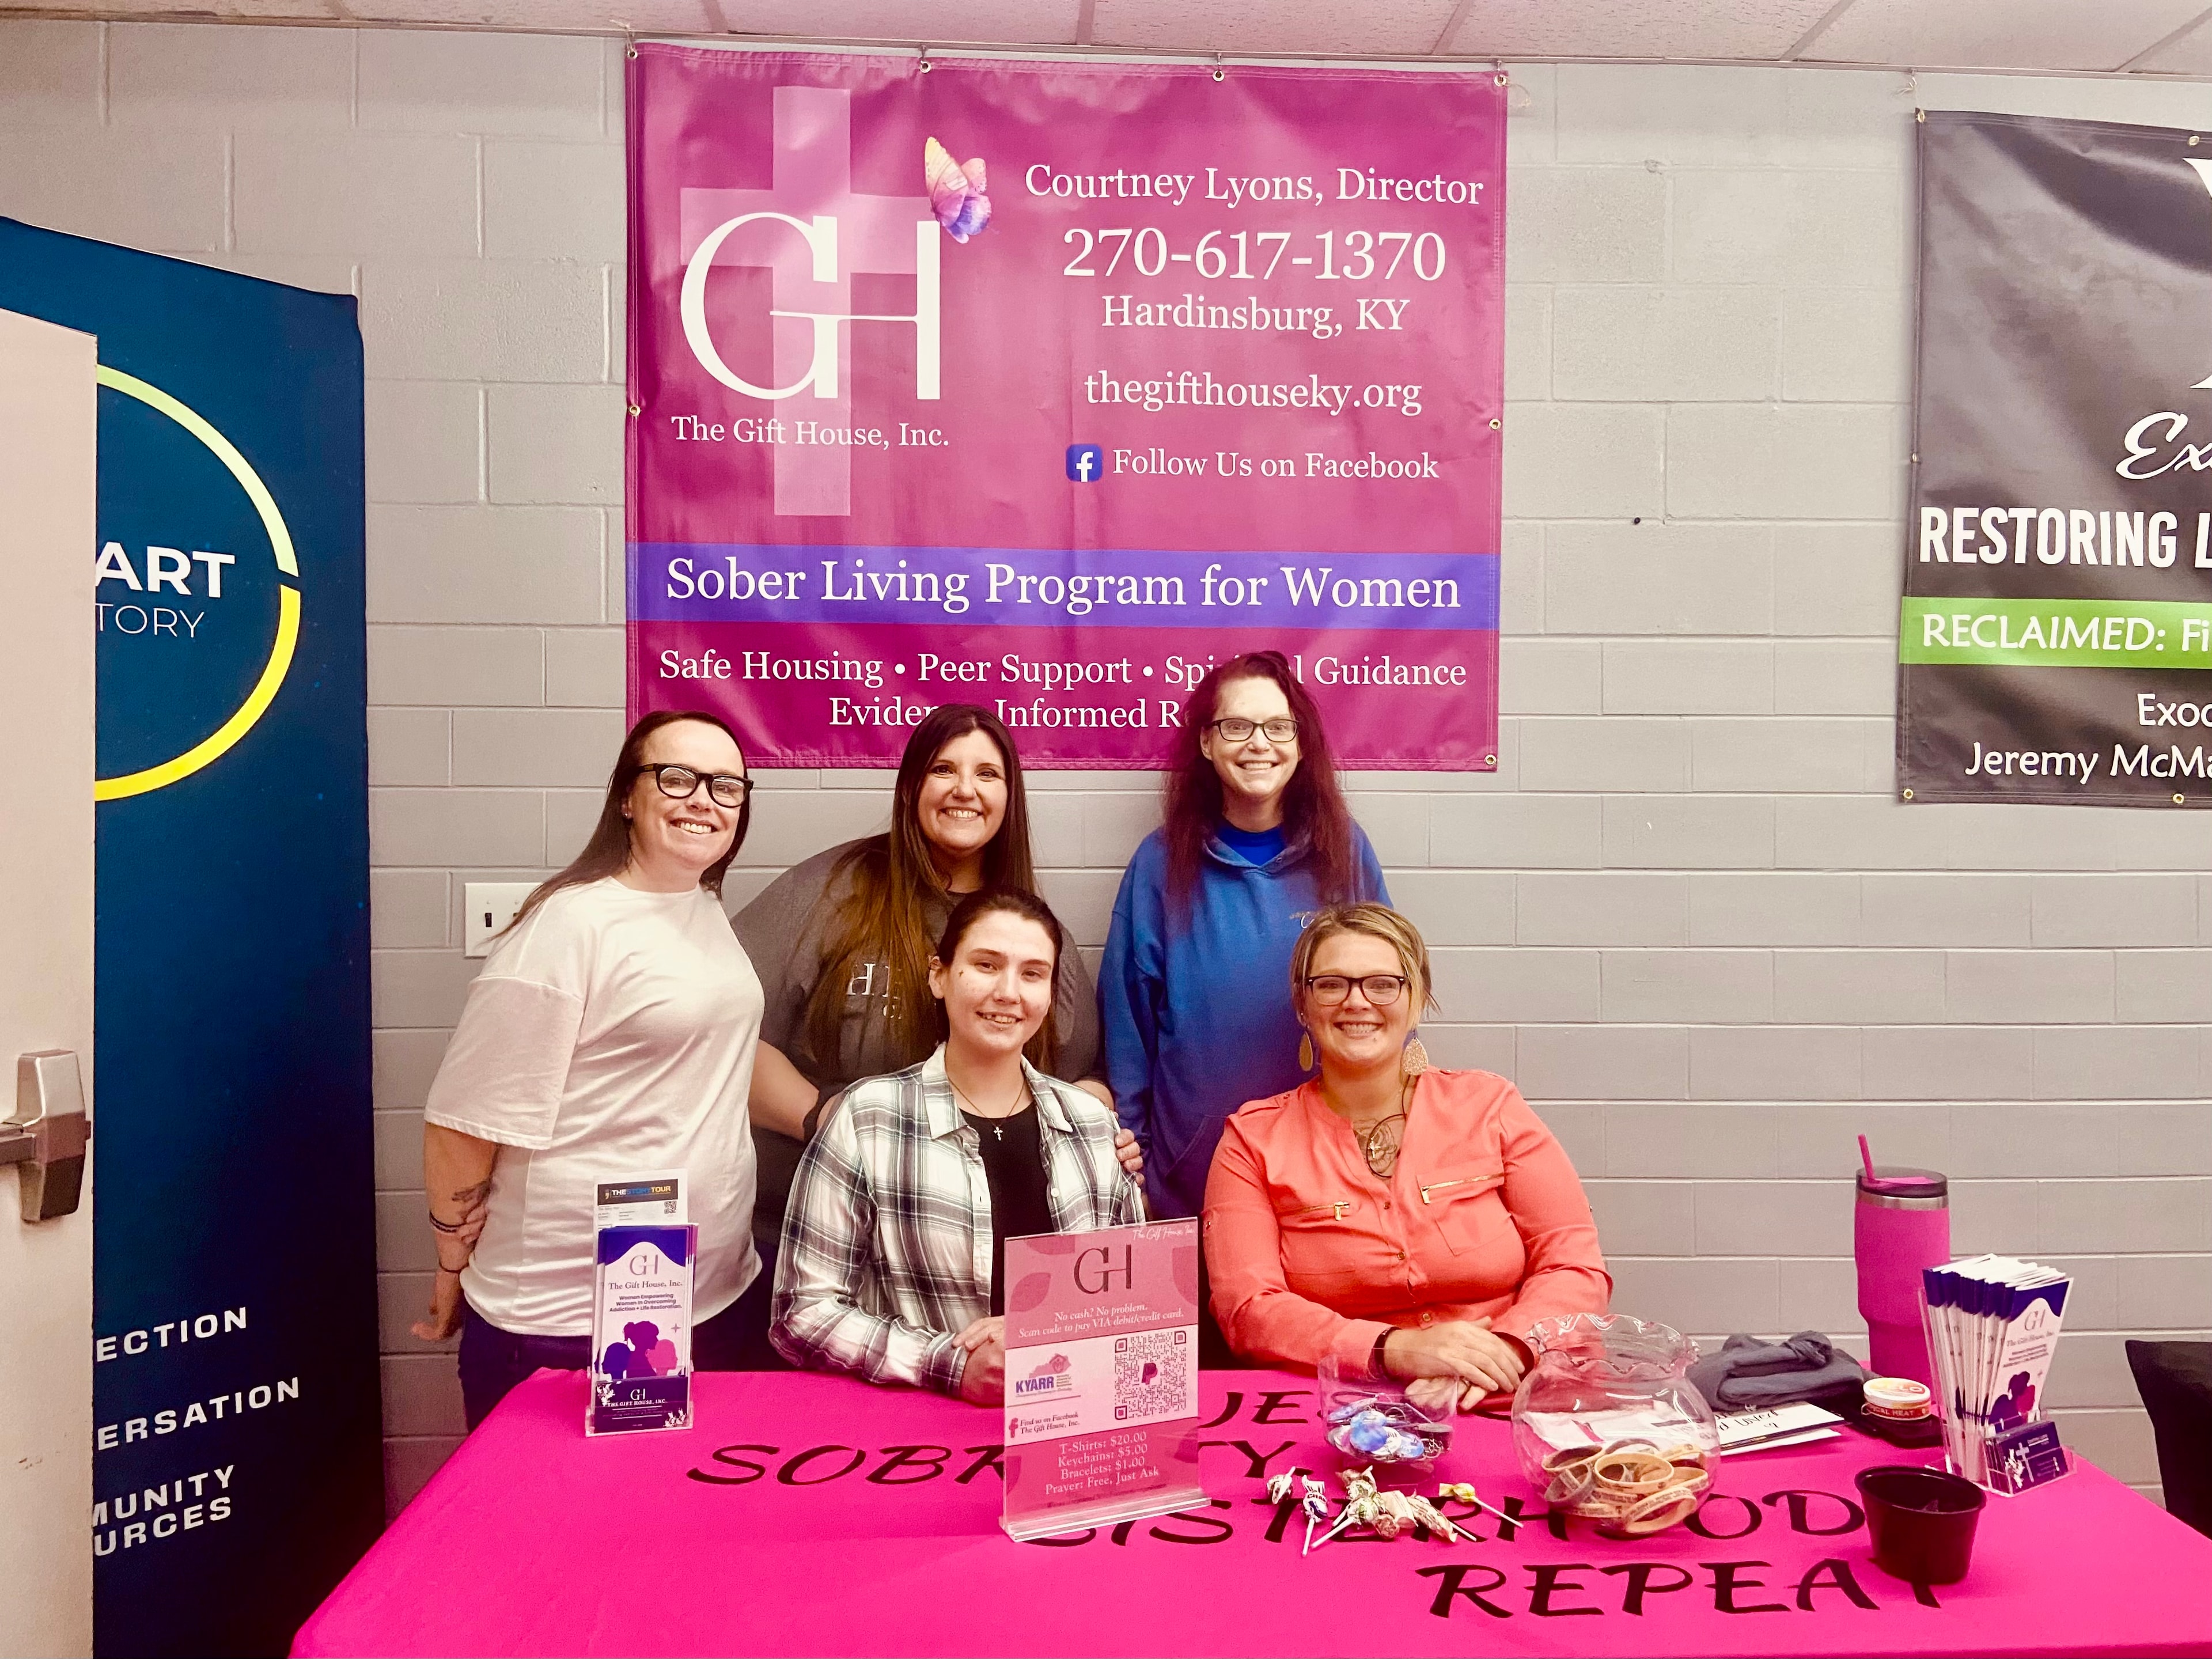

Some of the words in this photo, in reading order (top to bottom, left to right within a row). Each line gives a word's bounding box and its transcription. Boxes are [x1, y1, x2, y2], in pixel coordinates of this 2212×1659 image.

[1025, 164, 1195, 206] Courtney
[1205, 168, 1323, 209] Lyons,
[1336, 167, 1484, 204] Director
[1063, 228, 1446, 281] 270-617-1370
[1101, 293, 1342, 339] Hardinsburg,
[1355, 298, 1411, 330] KY
[1084, 370, 1422, 416] thegifthouseky.org
[671, 416, 725, 442] The
[733, 418, 787, 445] Gift
[794, 421, 889, 450] House,
[898, 423, 949, 446] Inc.
[1112, 448, 1208, 476] Follow
[1215, 452, 1252, 476] Us
[1260, 459, 1297, 477] on
[1305, 452, 1440, 478] Facebook
[1919, 506, 2176, 569] RESTORING
[667, 556, 806, 600] Sober
[821, 559, 970, 613] Living
[984, 563, 1184, 616] Program
[1200, 563, 1268, 606] for
[1279, 567, 1461, 608] Women
[1923, 614, 2165, 652] RECLAIMED:
[660, 649, 731, 679] Safe
[742, 650, 883, 688] Housing
[918, 653, 991, 681] Peer
[1001, 654, 1132, 690] Support
[1315, 656, 1467, 685] Guidance
[1965, 741, 2099, 785] Jeremy
[625, 1281, 639, 1289] Gift
[1019, 1328, 1040, 1338] Scan
[1043, 1323, 1062, 1335] code
[1065, 1323, 1073, 1332] to
[1075, 1321, 1090, 1332] pay
[1092, 1317, 1111, 1328] VIA
[1113, 1310, 1160, 1328] debit/credit
[1162, 1308, 1184, 1320] card.
[1054, 1312, 1068, 1322] No
[1070, 1308, 1094, 1320] cash?
[1096, 1306, 1109, 1316] No
[1111, 1302, 1147, 1316] problem.
[1016, 1376, 1054, 1393] KYARR
[1020, 1418, 1034, 1427] Find
[1052, 1412, 1079, 1422] Facebook
[1033, 1425, 1045, 1433] Gift
[1058, 1451, 1114, 1467] Keychains:
[1118, 1444, 1147, 1458] $5.00
[1059, 1440, 1107, 1455] T-Shirts:
[1110, 1431, 1147, 1446] $20.00
[1060, 1464, 1111, 1480] Bracelets:
[1115, 1456, 1145, 1471] $1.00
[1116, 1472, 1137, 1485] Just
[1139, 1466, 1159, 1478] Ask
[1415, 1557, 1941, 1618] REPEA
